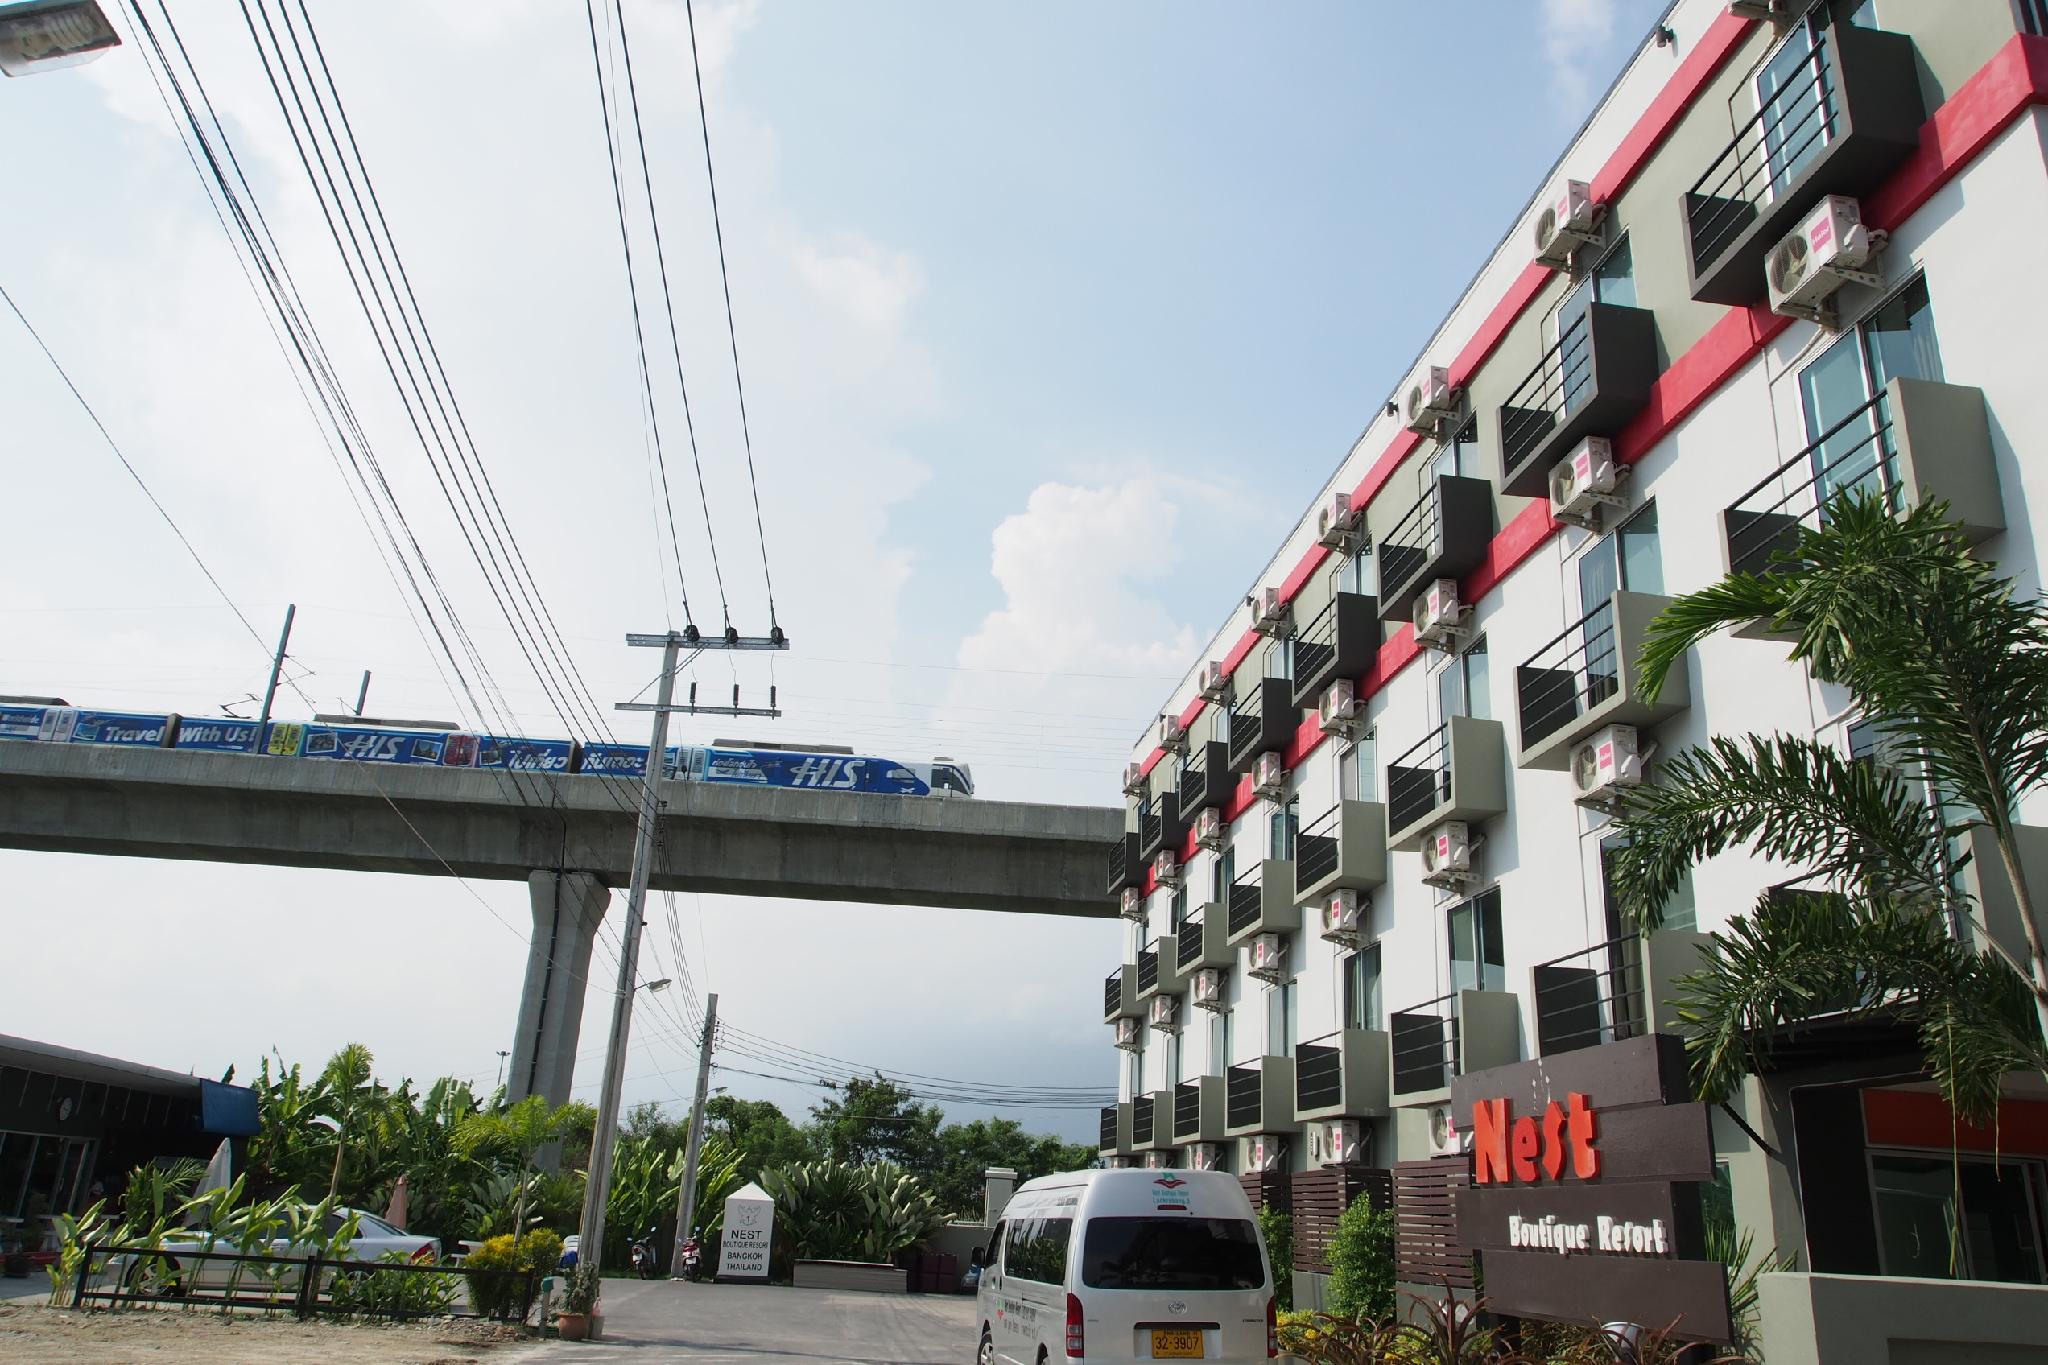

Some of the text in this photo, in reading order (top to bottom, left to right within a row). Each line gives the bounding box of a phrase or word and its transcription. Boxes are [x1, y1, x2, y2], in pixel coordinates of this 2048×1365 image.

[105, 726, 256, 742] Travel With Us!
[1473, 1091, 1600, 1183] Nest
[731, 1230, 762, 1239] NEST
[1508, 1214, 1668, 1254] Boutique Resort
[727, 1251, 762, 1260] BANGKOK
[727, 1263, 762, 1271] THAILAND
[1155, 1336, 1199, 1350] 32-3907
